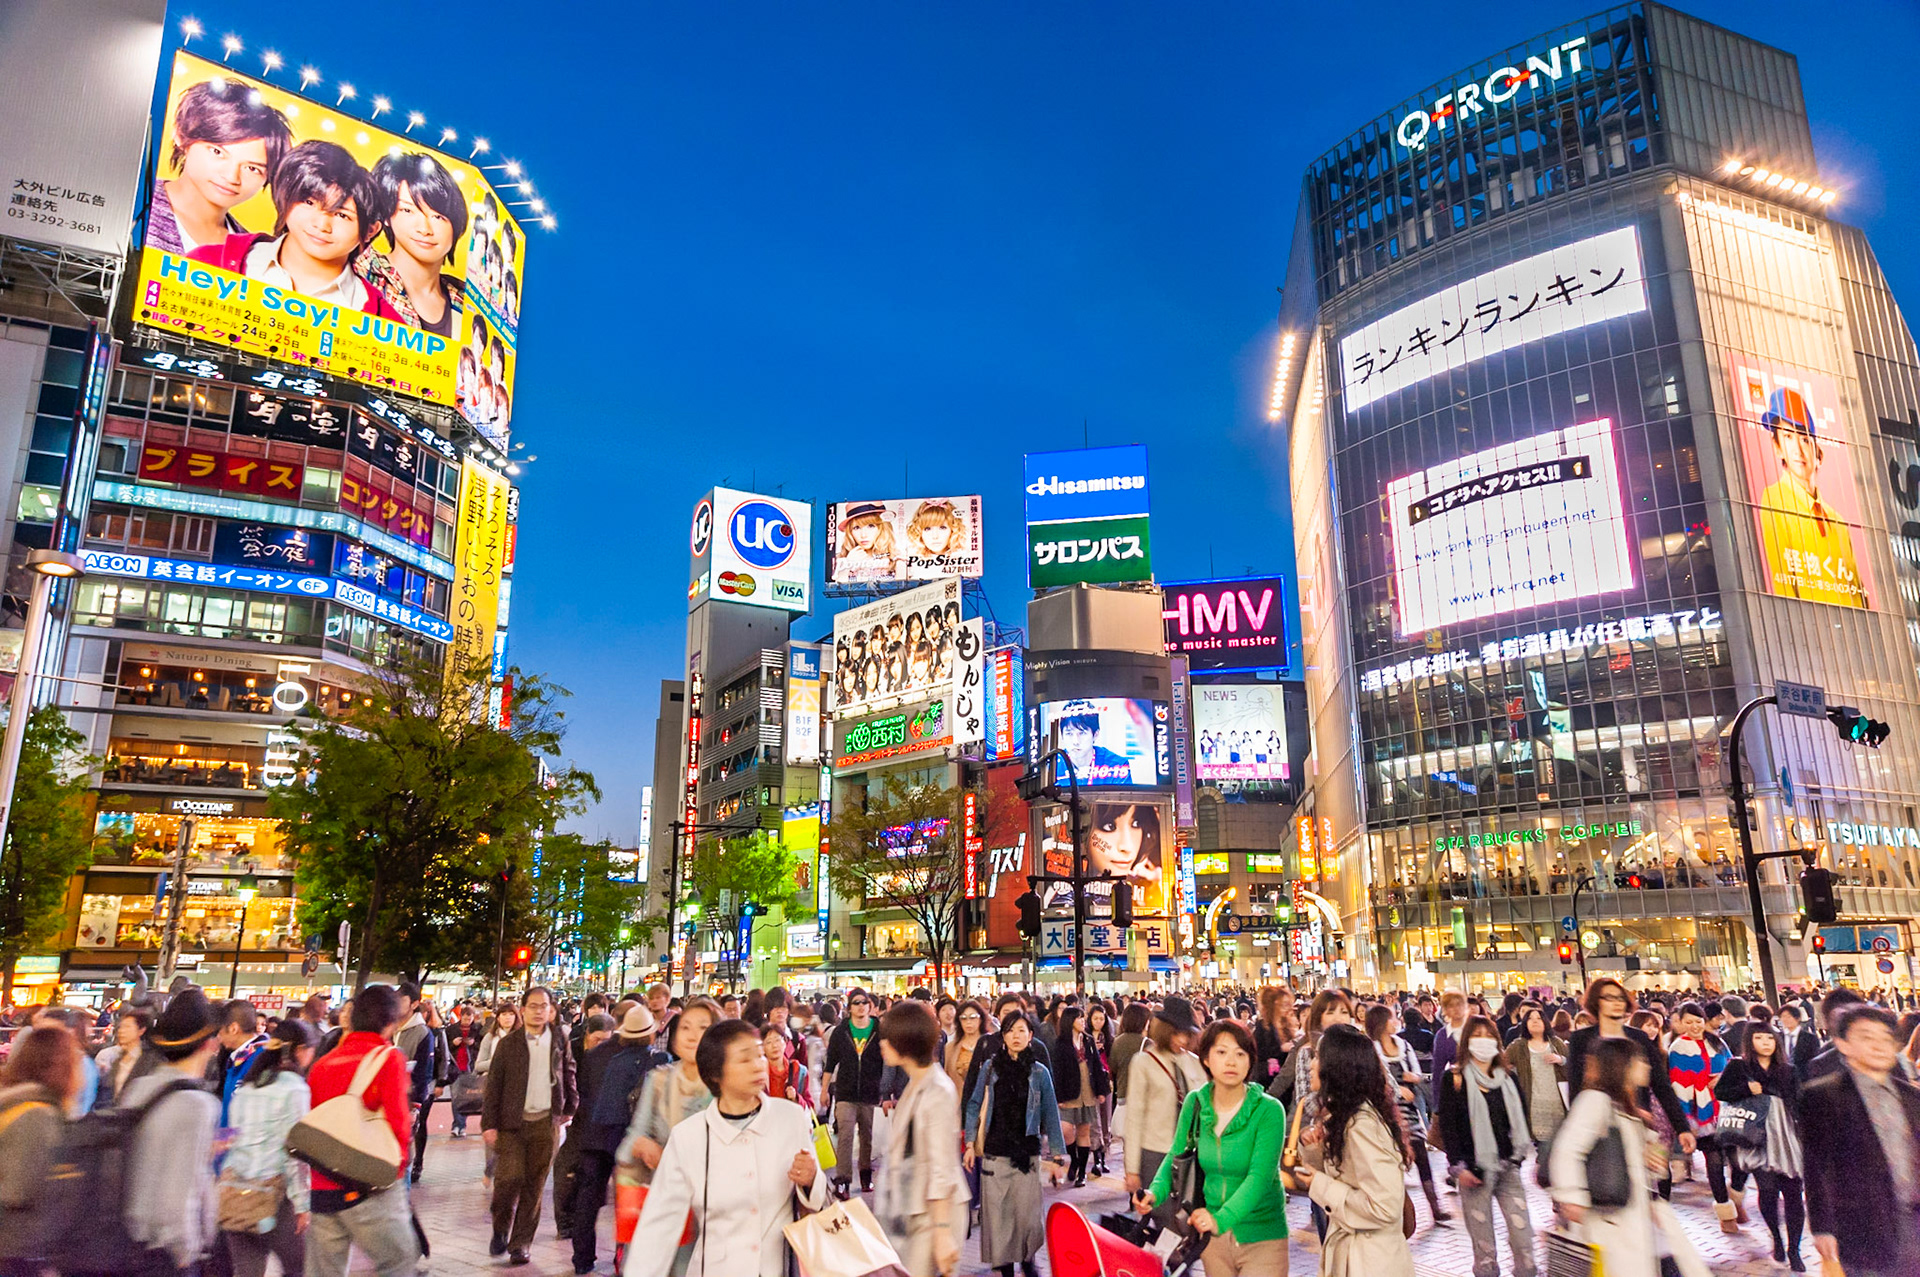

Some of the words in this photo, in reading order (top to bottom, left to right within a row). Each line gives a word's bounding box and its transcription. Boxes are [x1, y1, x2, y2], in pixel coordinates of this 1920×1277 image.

[1396, 36, 1588, 151] QFRONT
[10, 193, 57, 212] 連絡先
[13, 179, 105, 207] 大外ビル広告
[8, 207, 101, 234] 03-3292-3681
[145, 283, 159, 306] 4月
[160, 255, 249, 300] Hey!
[262, 287, 339, 327] Say!
[352, 316, 446, 355] JUMP
[1352, 267, 1624, 385] ランキンランキン
[320, 333, 332, 354] 5月
[145, 447, 296, 490] プライス
[1026, 475, 1146, 496] Hisamitsu
[342, 477, 430, 536] コンタクト
[320, 515, 335, 526] 7F
[907, 554, 979, 569] PopSister
[1034, 535, 1144, 565] サロンパス
[85, 553, 141, 573] AEON
[152, 560, 294, 591] 英会話イーオン
[1783, 547, 1854, 582] 怪物くん
[304, 580, 323, 591] 6F
[718, 577, 755, 590] MasterCard
[775, 585, 804, 599] VISA
[340, 585, 373, 608] AEON
[377, 598, 451, 637] 英会話イーオン
[1162, 588, 1273, 635] HMV
[1183, 638, 1222, 650] music
[1228, 634, 1277, 647] master
[165, 650, 209, 662] Natural
[214, 653, 253, 668] Dining
[1024, 661, 1048, 671] Mighty
[1049, 659, 1071, 668] Vision
[955, 625, 980, 736] もんじゃ
[996, 654, 1009, 753] 三千里薬品
[1172, 676, 1188, 733] Taisei
[1203, 690, 1238, 702] NEWS
[1780, 686, 1823, 705] 渋谷駅前
[795, 715, 812, 725] B1F
[795, 727, 812, 737] B2F
[871, 723, 906, 749] 西村
[1157, 723, 1169, 776] フジテレビ
[1175, 737, 1188, 785] neon
[1202, 766, 1255, 777] さくらガール
[172, 800, 234, 813] L'OCCITANE
[1435, 828, 1548, 852] STARBUCKS
[1559, 820, 1643, 841] COFFEE
[1827, 823, 1920, 848] TSUTAYA
[988, 832, 1027, 898] クスリ
